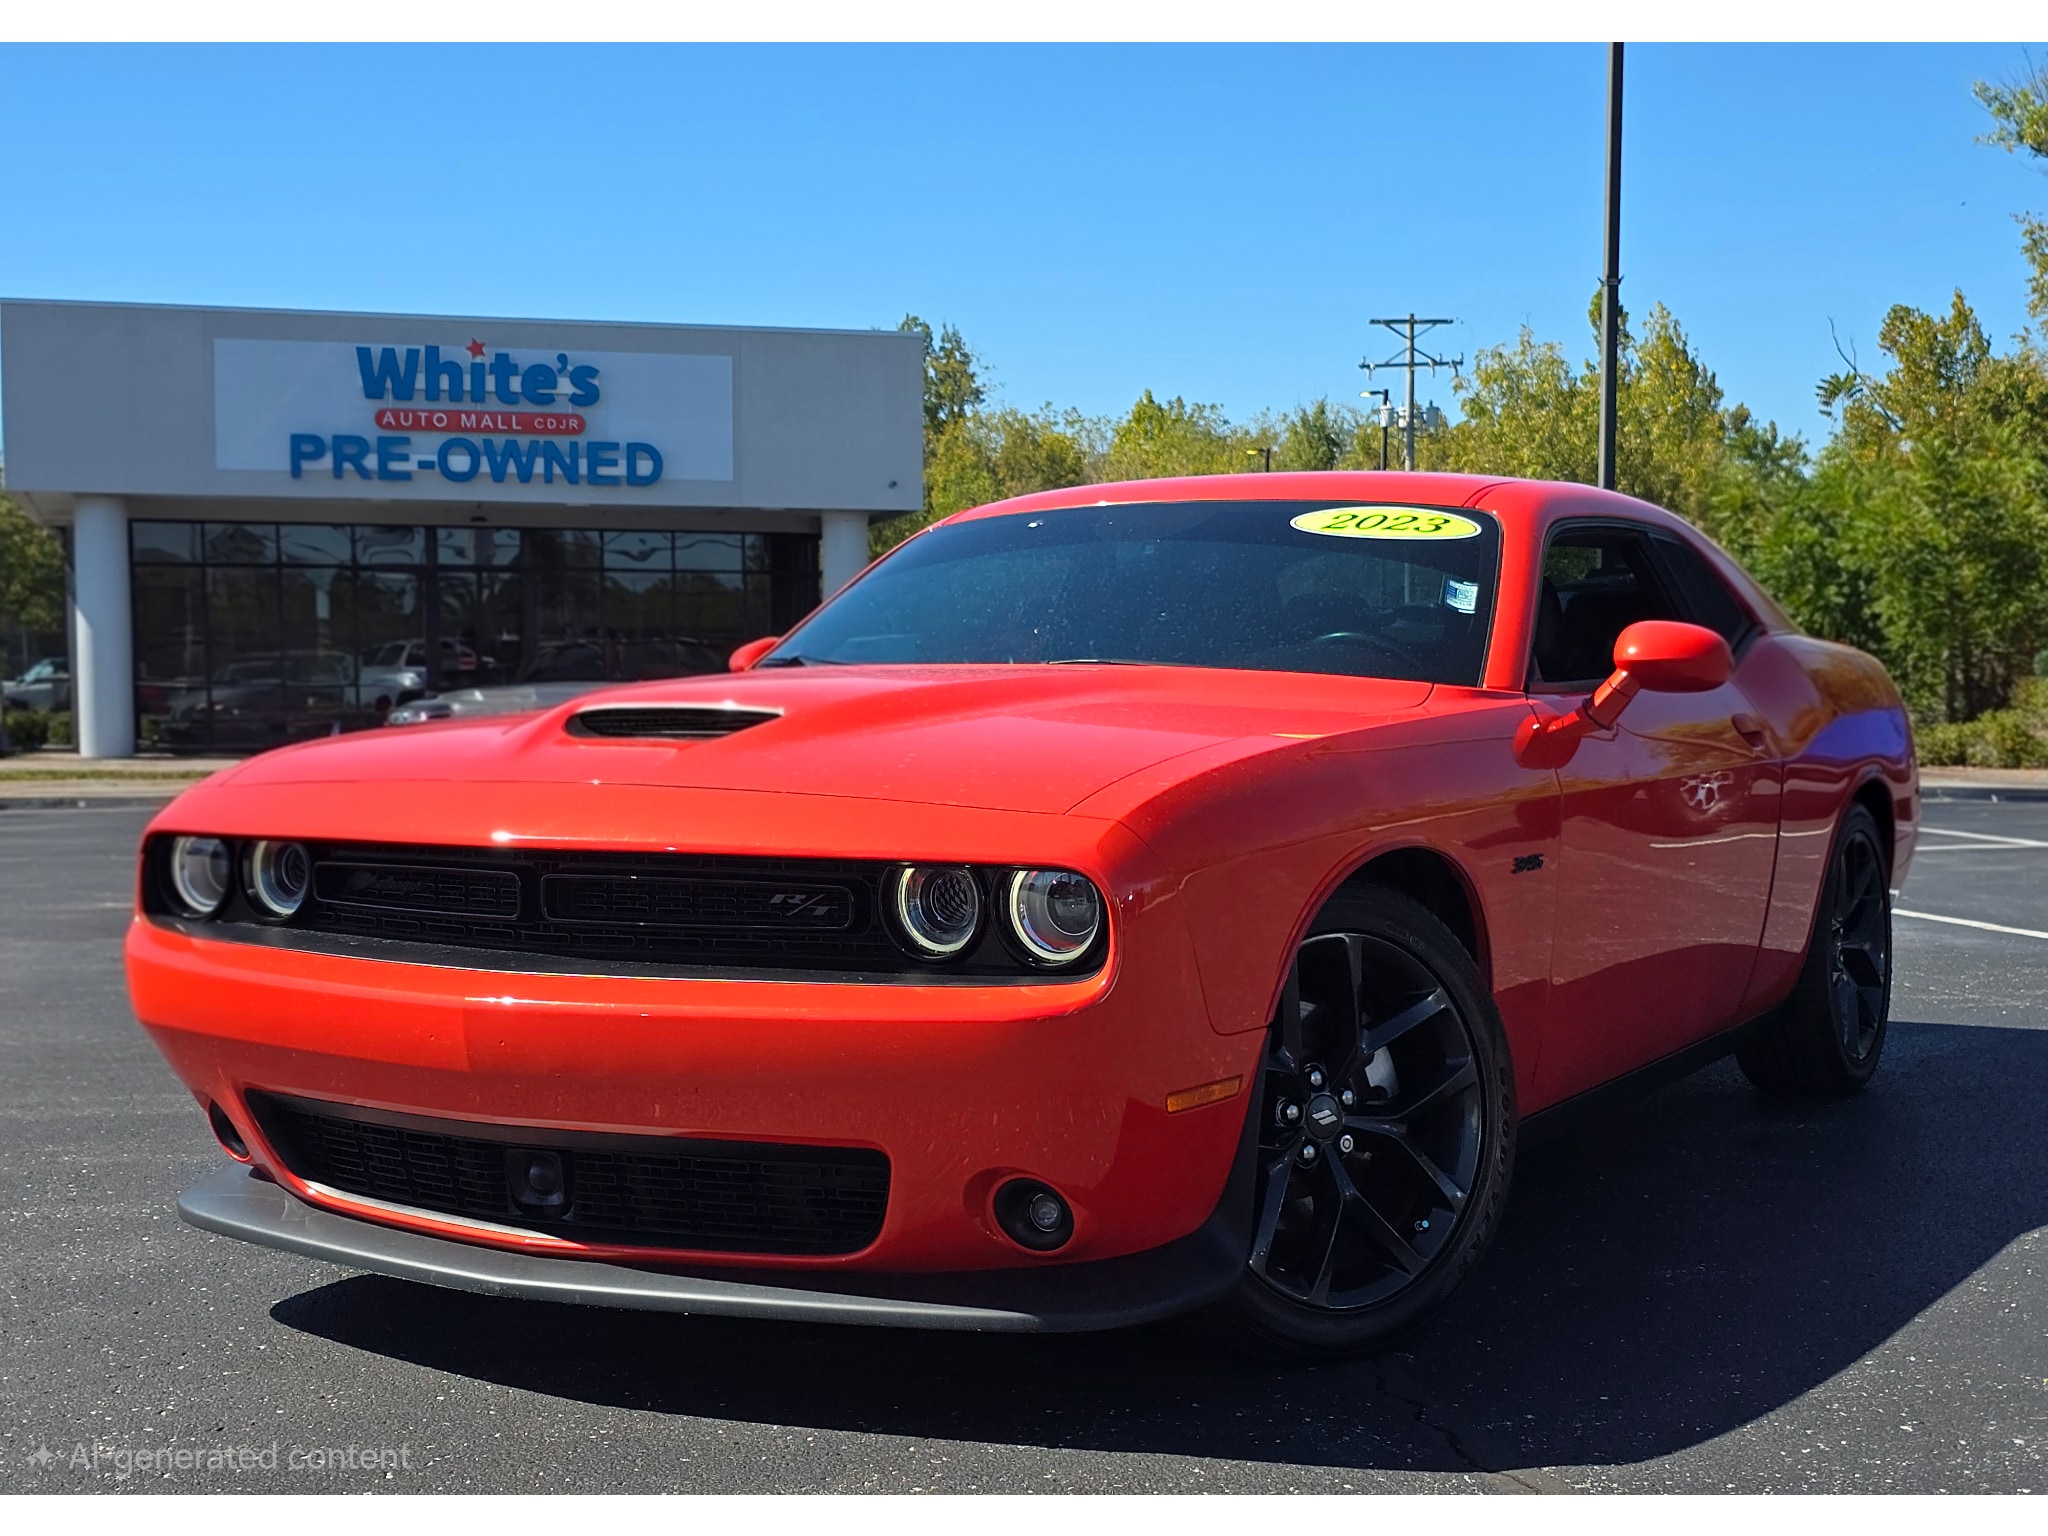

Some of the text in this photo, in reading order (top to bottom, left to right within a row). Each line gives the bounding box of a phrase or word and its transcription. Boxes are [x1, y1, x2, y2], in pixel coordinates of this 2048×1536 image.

[356, 339, 601, 406] White's
[382, 411, 579, 430] AUTO MALL CDJR
[289, 432, 664, 487] PRE-OWNED
[1320, 513, 1451, 533] 2023
[769, 893, 839, 917] R/T
